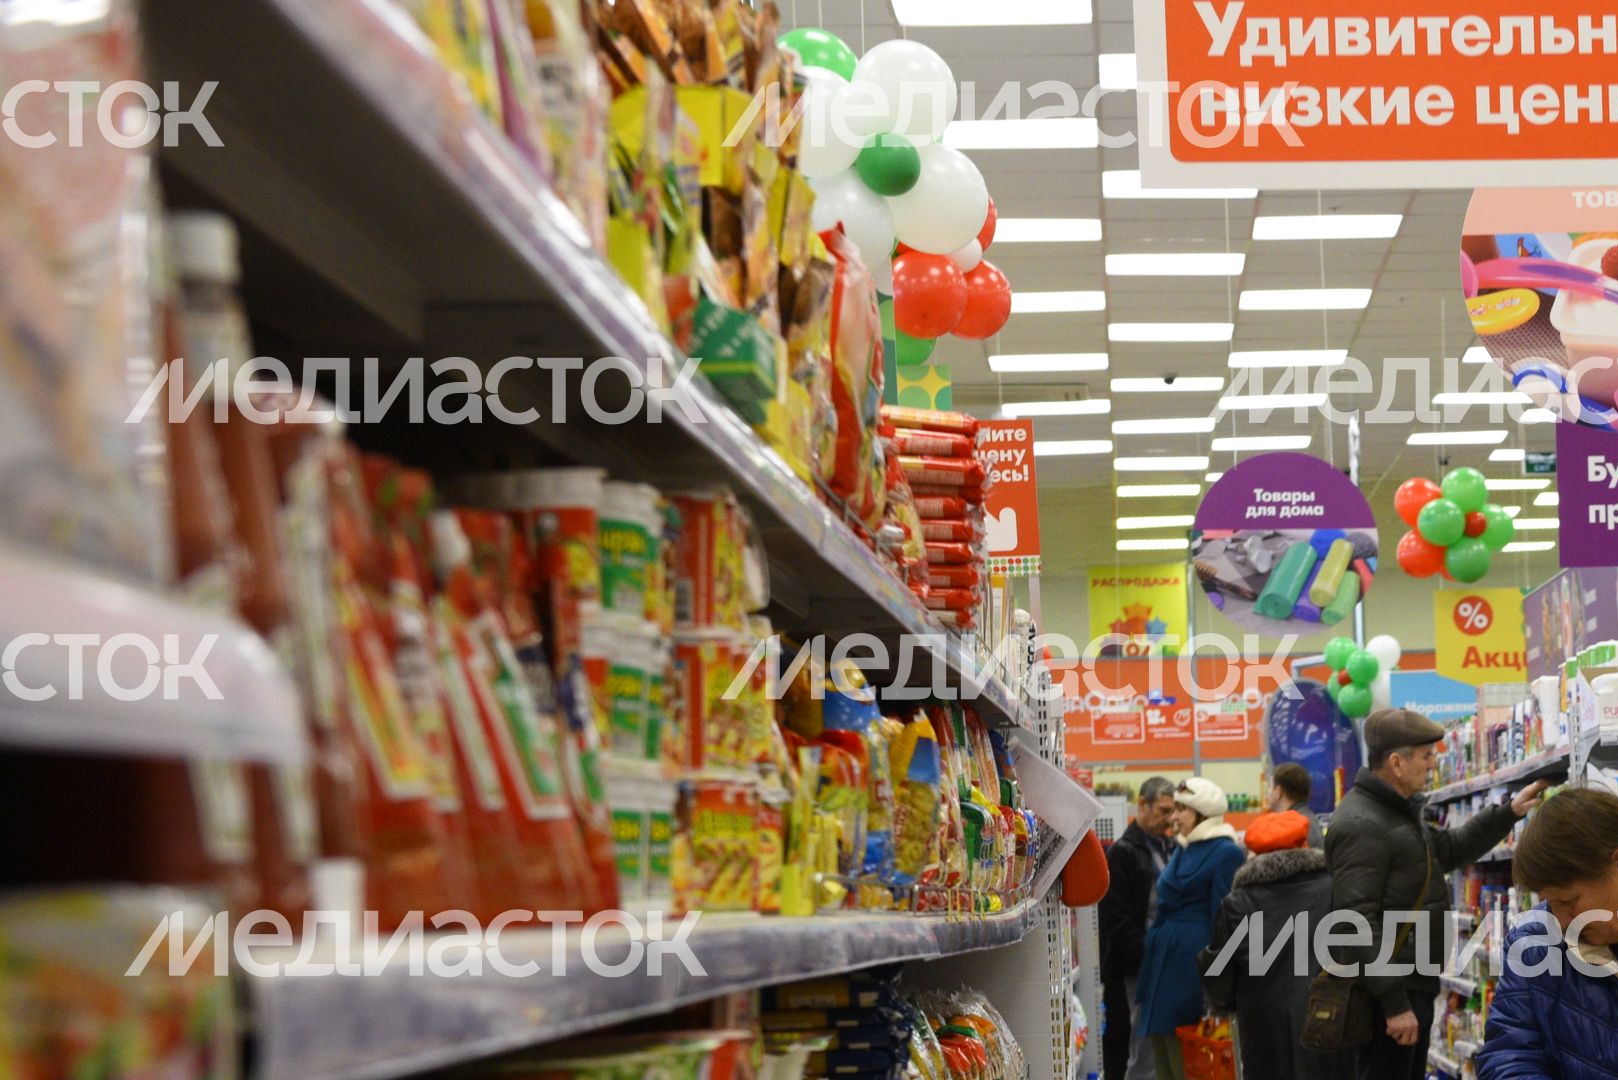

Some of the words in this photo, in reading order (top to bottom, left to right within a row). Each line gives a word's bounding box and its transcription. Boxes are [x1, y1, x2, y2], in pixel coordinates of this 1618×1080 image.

[1199, 84, 1454, 127] низкие
[985, 463, 1029, 483] есь!
[1253, 488, 1315, 506] Товары
[1245, 505, 1276, 519] для
[1279, 505, 1325, 519] дома
[1091, 576, 1181, 589] РАСПРОДАЖА
